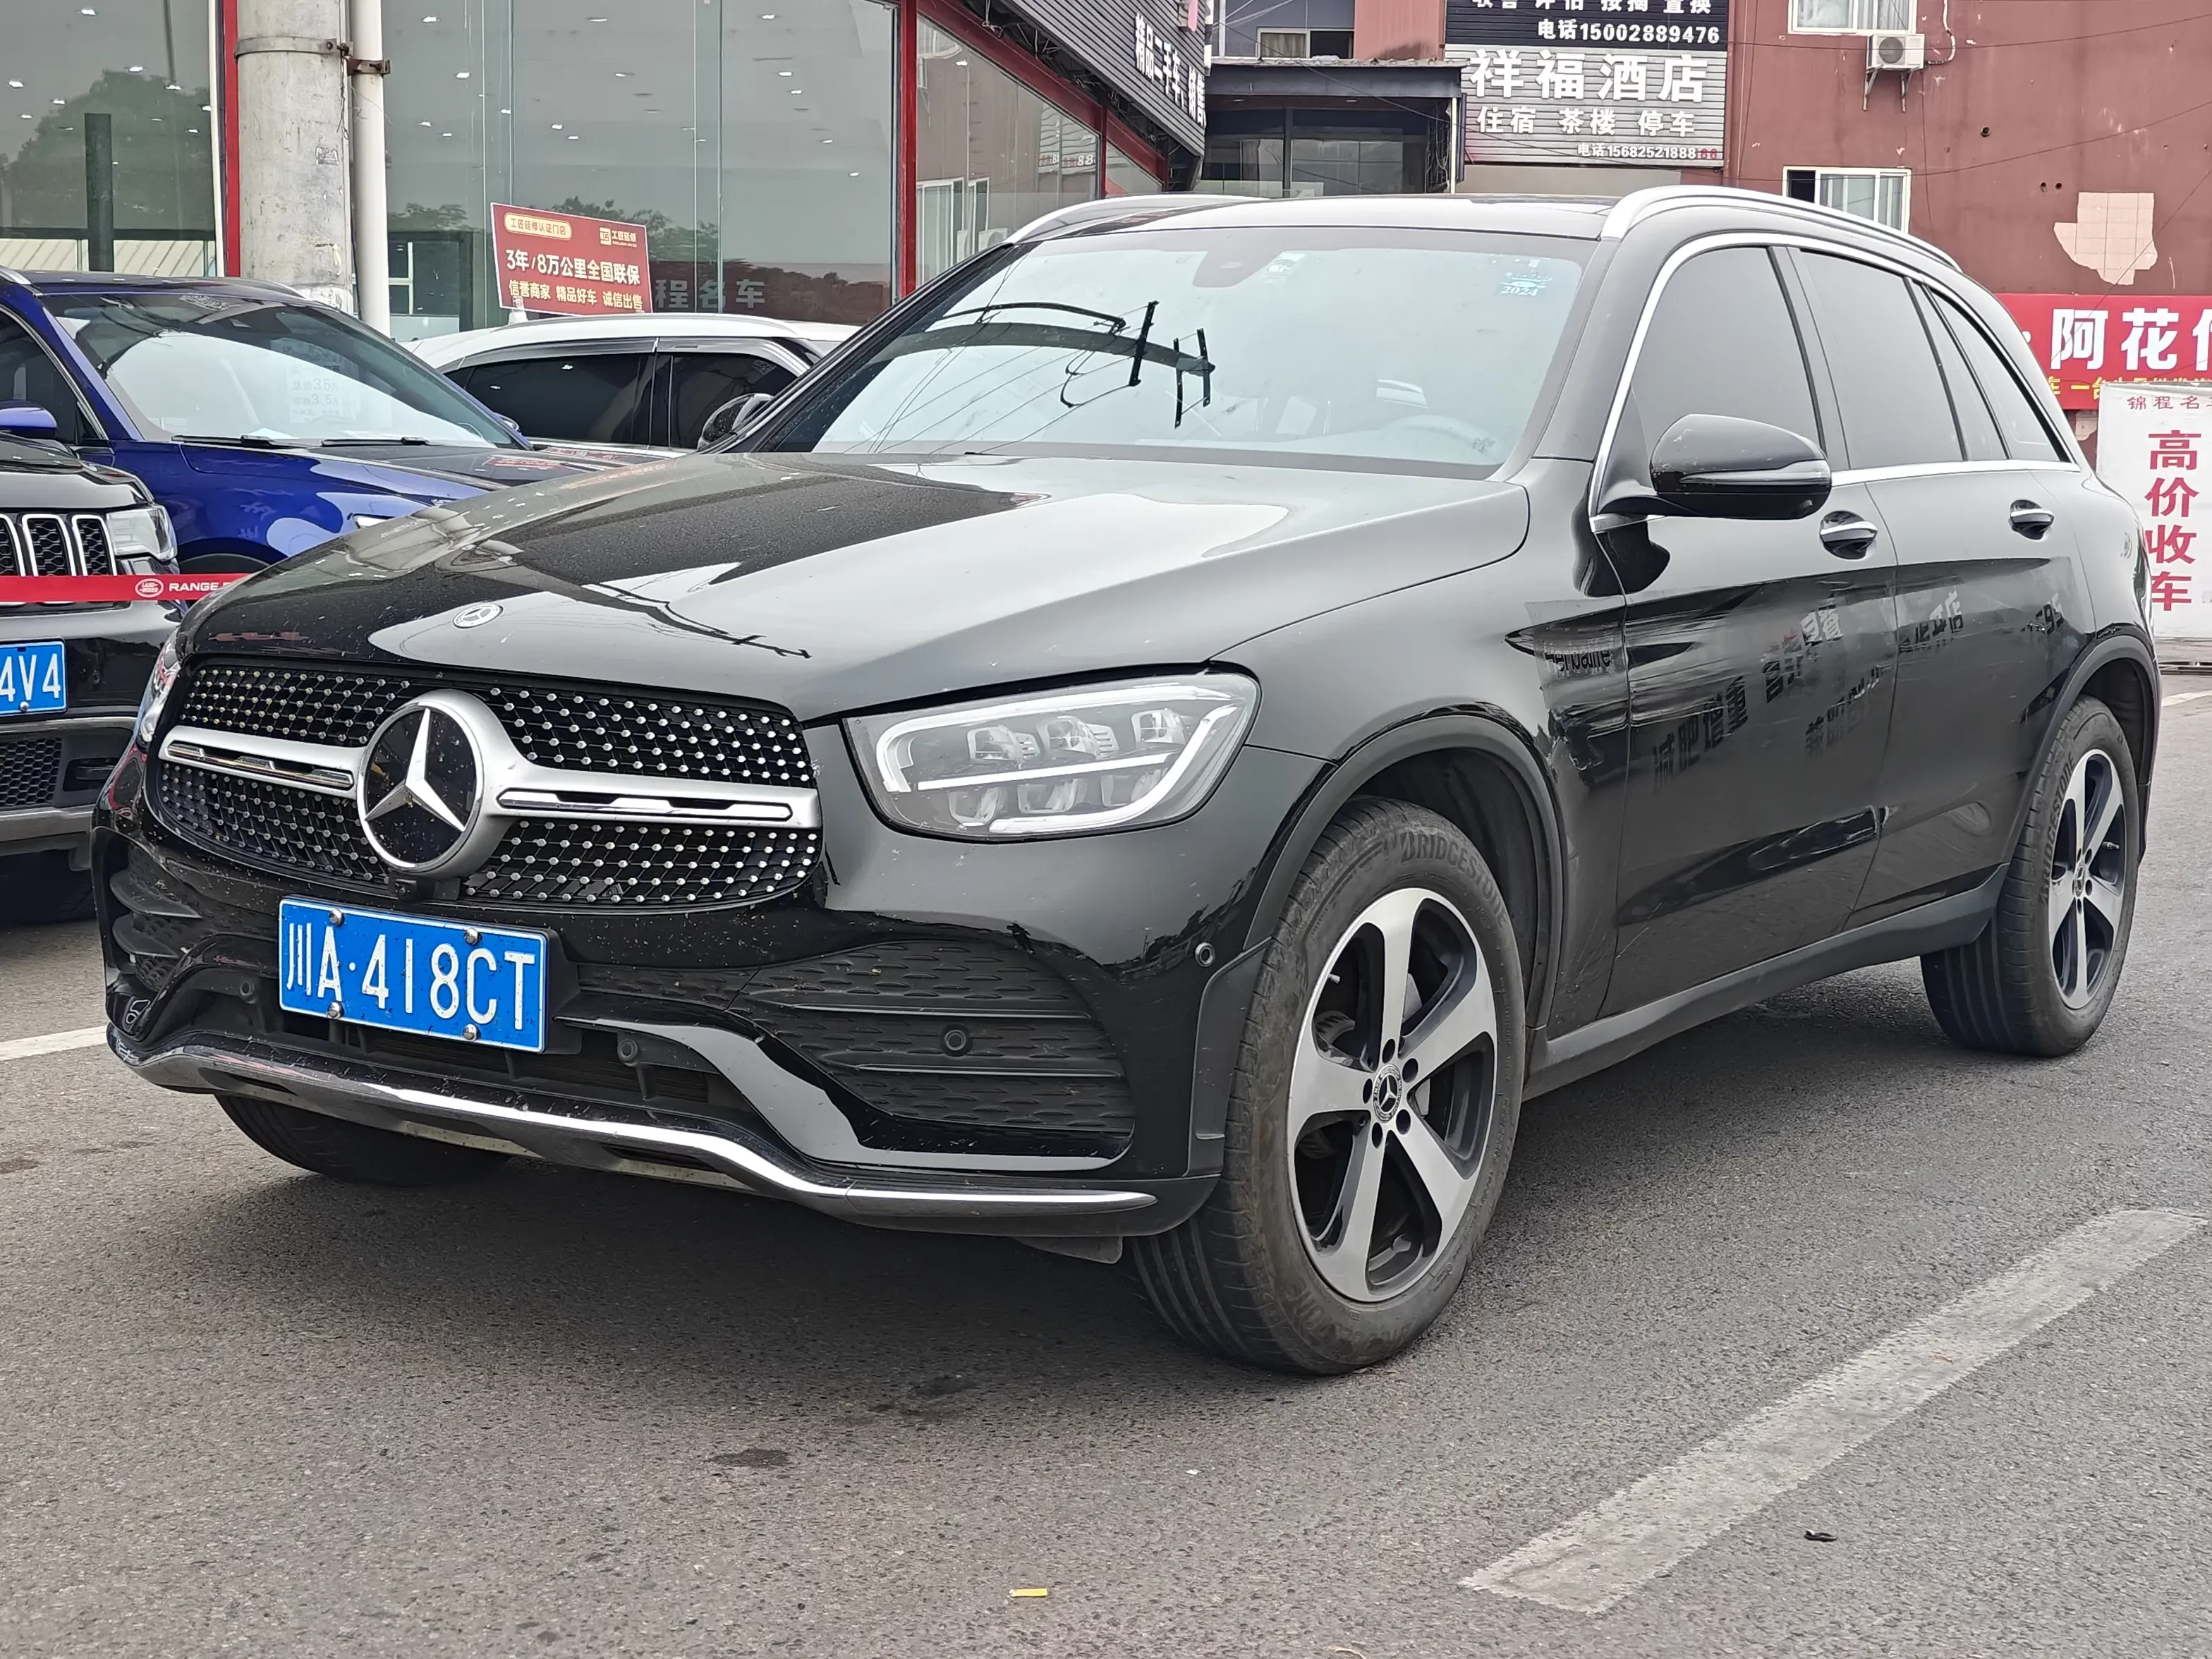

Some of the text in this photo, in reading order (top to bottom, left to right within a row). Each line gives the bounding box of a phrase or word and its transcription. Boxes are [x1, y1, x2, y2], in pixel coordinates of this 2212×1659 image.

[1538, 18, 1720, 44] 电话15002889476
[1469, 48, 1708, 102] 祥福酒店
[1476, 106, 1695, 137] 住宿 茶楼 停车
[1577, 142, 1696, 160] 电话15682521888
[505, 249, 640, 285] 3年/8万公里全国联保
[509, 279, 643, 310] 信誉商家 精品好车 诚信出售
[1500, 286, 1539, 297] 2024
[2144, 430, 2201, 612] 高价收车
[169, 582, 219, 592] RANGE
